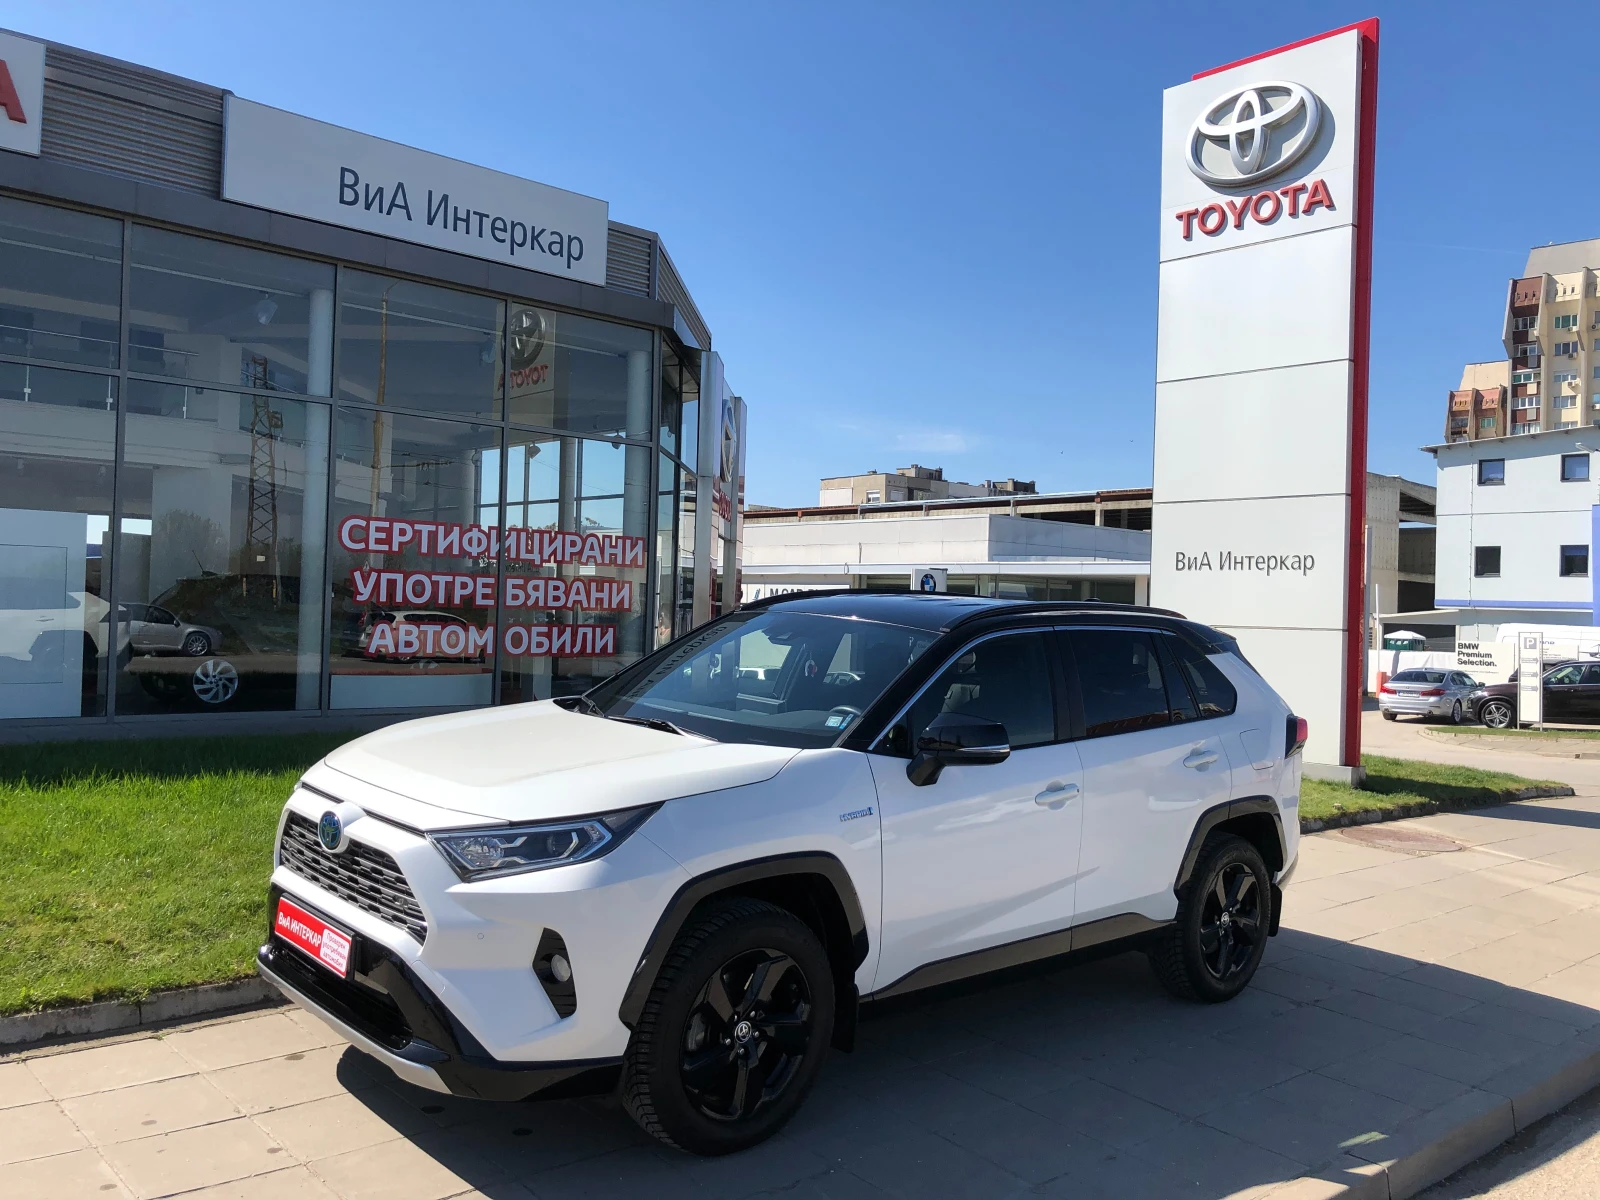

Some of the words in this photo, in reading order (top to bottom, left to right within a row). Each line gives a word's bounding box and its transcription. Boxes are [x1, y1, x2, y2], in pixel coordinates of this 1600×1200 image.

[338, 166, 413, 221] ВиА
[426, 189, 584, 270] Интеркар
[1175, 178, 1335, 240] TOYOTA
[340, 517, 645, 566] СЕРТИФИЦИРАНИ
[1175, 551, 1212, 572] ВиА
[1219, 551, 1315, 577] Интеркар
[1457, 642, 1480, 651] BMW
[1457, 650, 1493, 659] Premium
[1457, 658, 1498, 667] Selection.
[278, 912, 291, 930] ВиА
[290, 918, 322, 948] ИНТЕРКАР
